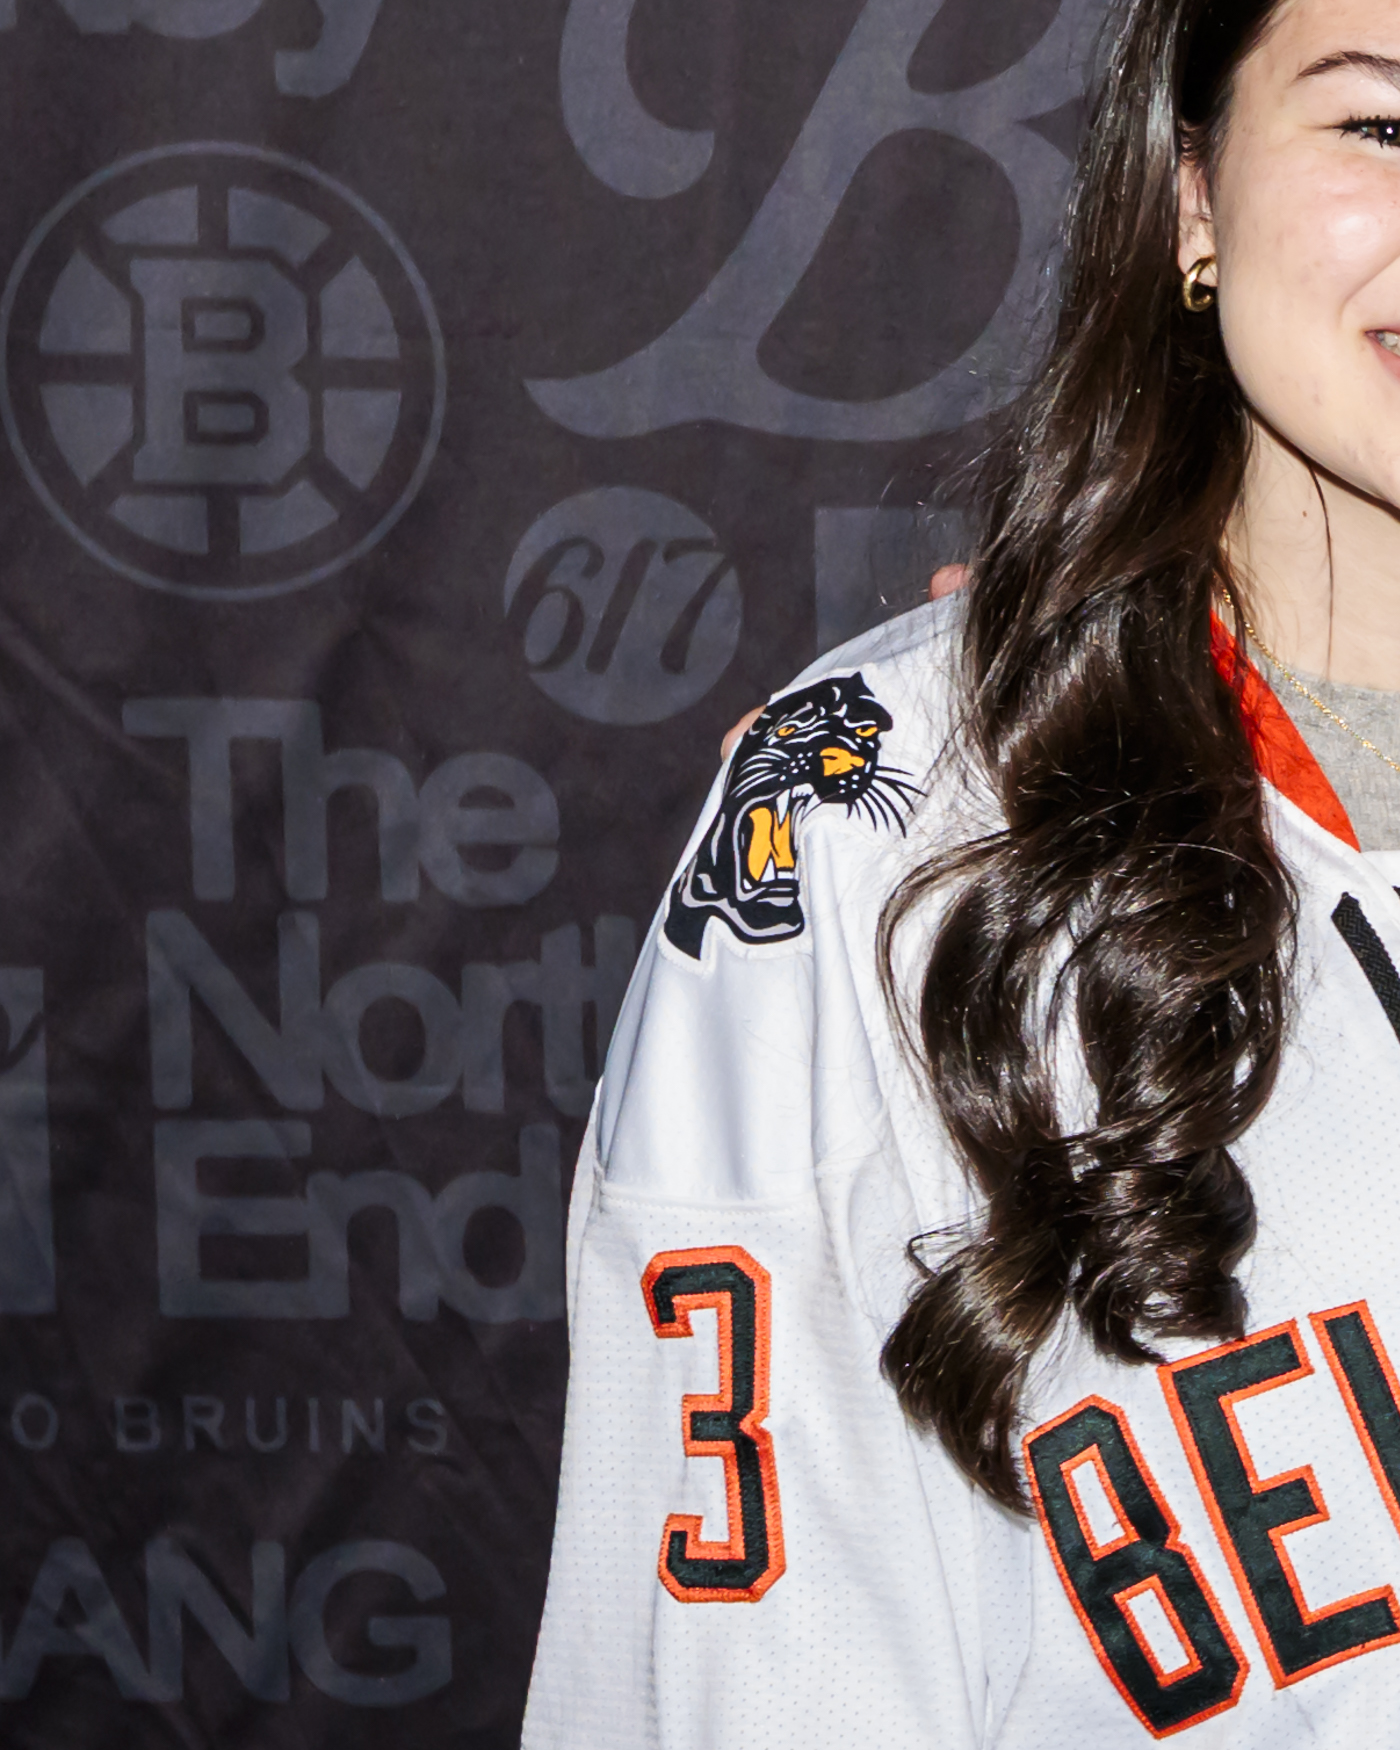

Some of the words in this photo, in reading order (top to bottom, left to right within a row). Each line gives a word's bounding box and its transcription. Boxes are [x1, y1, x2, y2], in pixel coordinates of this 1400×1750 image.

[122, 695, 561, 908] The
[152, 1117, 565, 1325] End
[113, 1396, 449, 1457] BRUINS
[641, 1244, 783, 1604] 3
